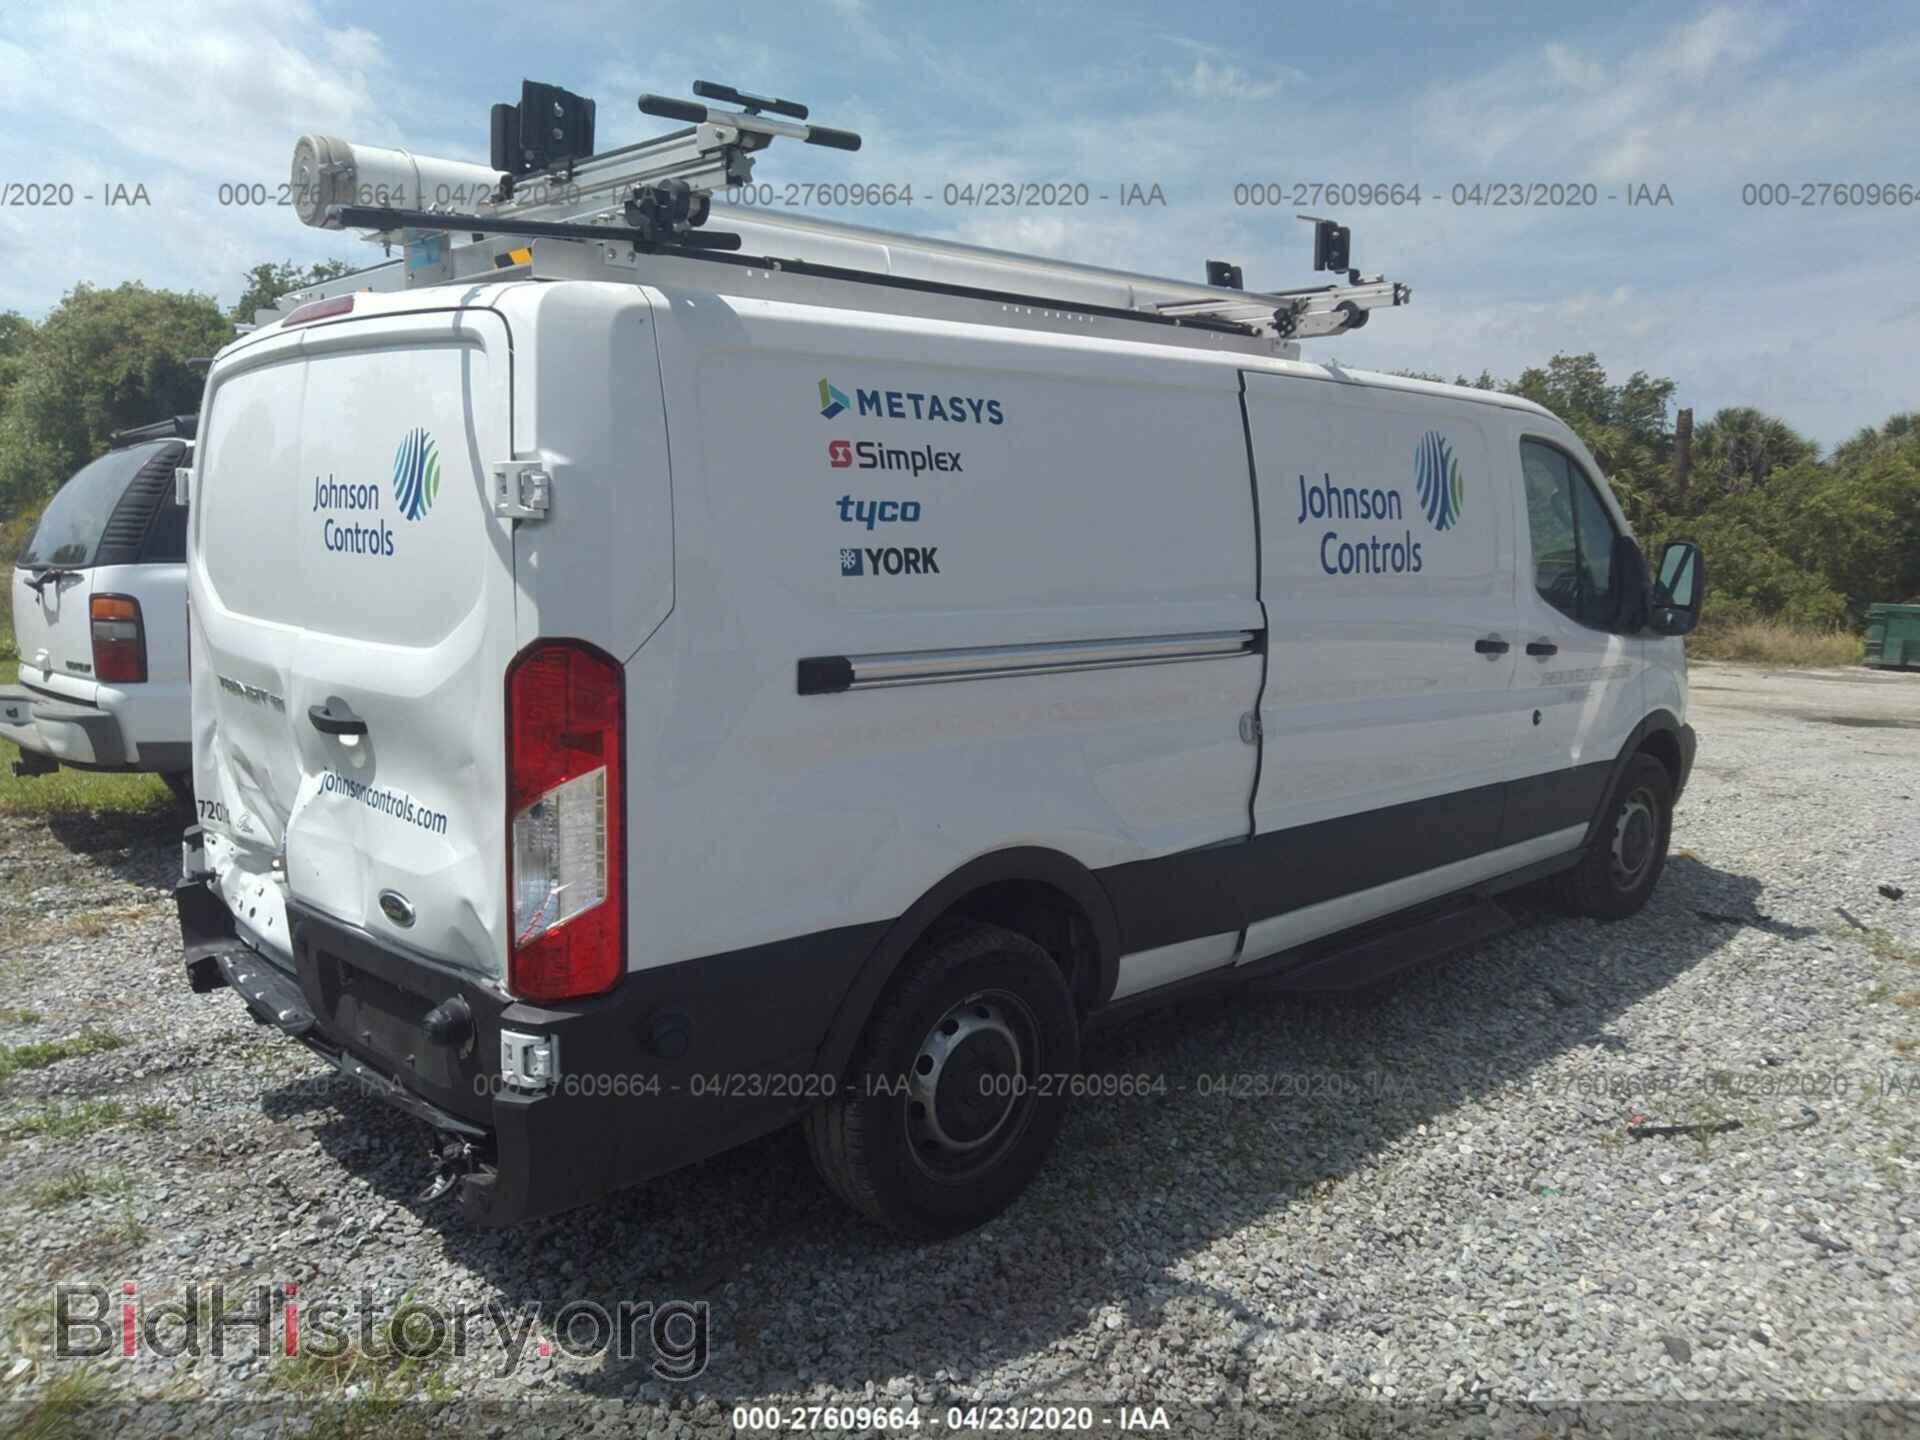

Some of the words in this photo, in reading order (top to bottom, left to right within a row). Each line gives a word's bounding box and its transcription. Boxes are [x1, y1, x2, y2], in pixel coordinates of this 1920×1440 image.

[856, 388, 1004, 425] METASYS
[855, 441, 963, 477] Simplex
[313, 473, 379, 512] Johnson
[1297, 473, 1402, 524] Johnson
[836, 494, 921, 530] tyco
[324, 518, 394, 556] Controls
[1321, 529, 1422, 575] Controls
[864, 547, 940, 576] YORK
[317, 766, 447, 834] johnsoncontrols.com
